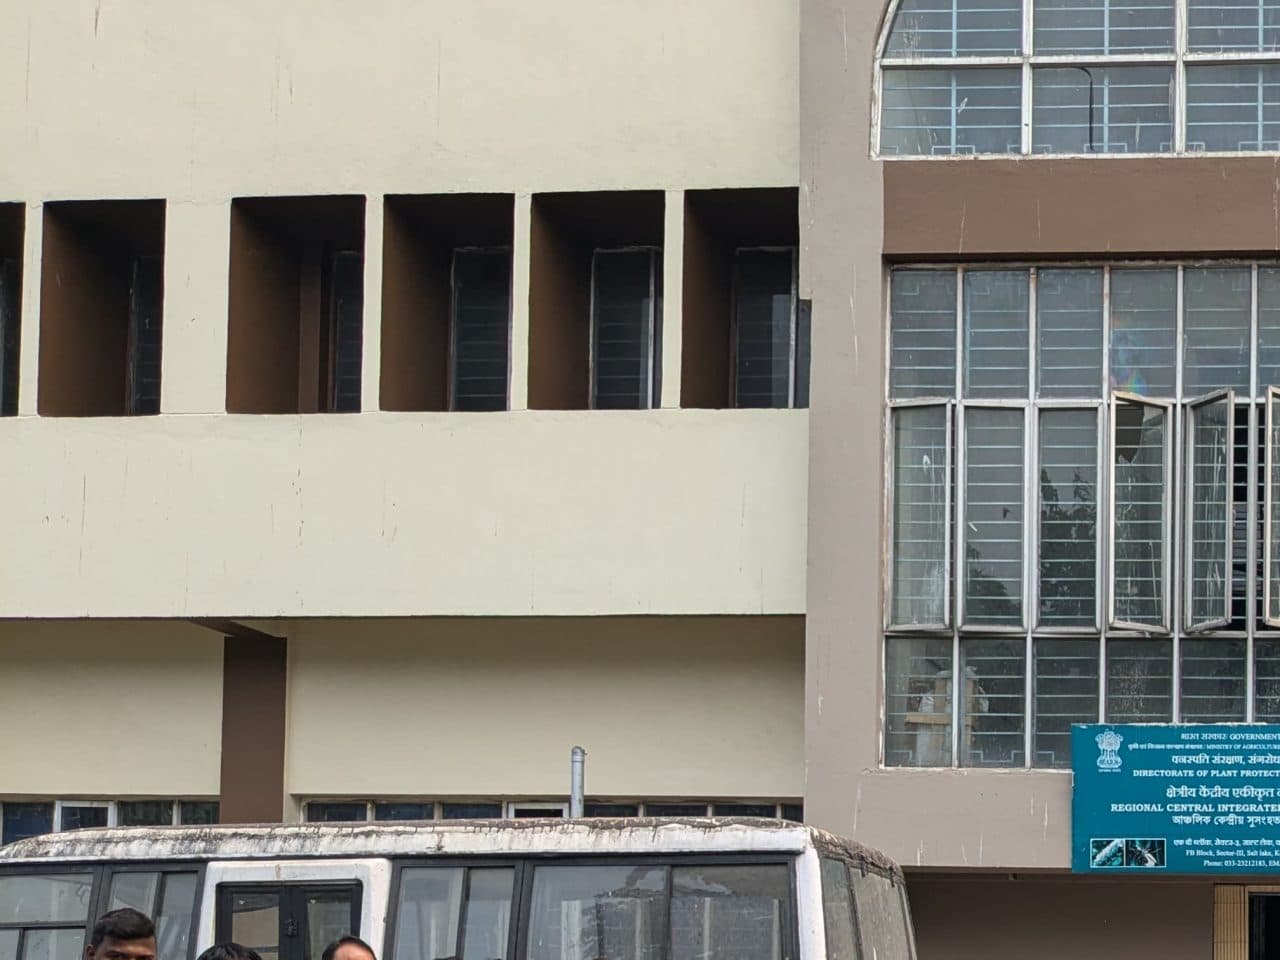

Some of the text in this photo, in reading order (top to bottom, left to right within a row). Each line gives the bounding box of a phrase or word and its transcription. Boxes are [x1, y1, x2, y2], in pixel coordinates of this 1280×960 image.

[1172, 752, 1209, 764] वनस्पति
[1248, 752, 1280, 764] संगरोध
[1133, 769, 1194, 777] DIRECTORATE
[1197, 769, 1208, 777] OF
[1211, 769, 1237, 777] PLANT
[1166, 785, 1196, 798] क्षेत्रीय
[1232, 785, 1274, 802] एकीकृत
[1111, 804, 1164, 812] REGIONAL
[1167, 804, 1215, 812] CENTRAL
[1246, 849, 1258, 857] Salt
